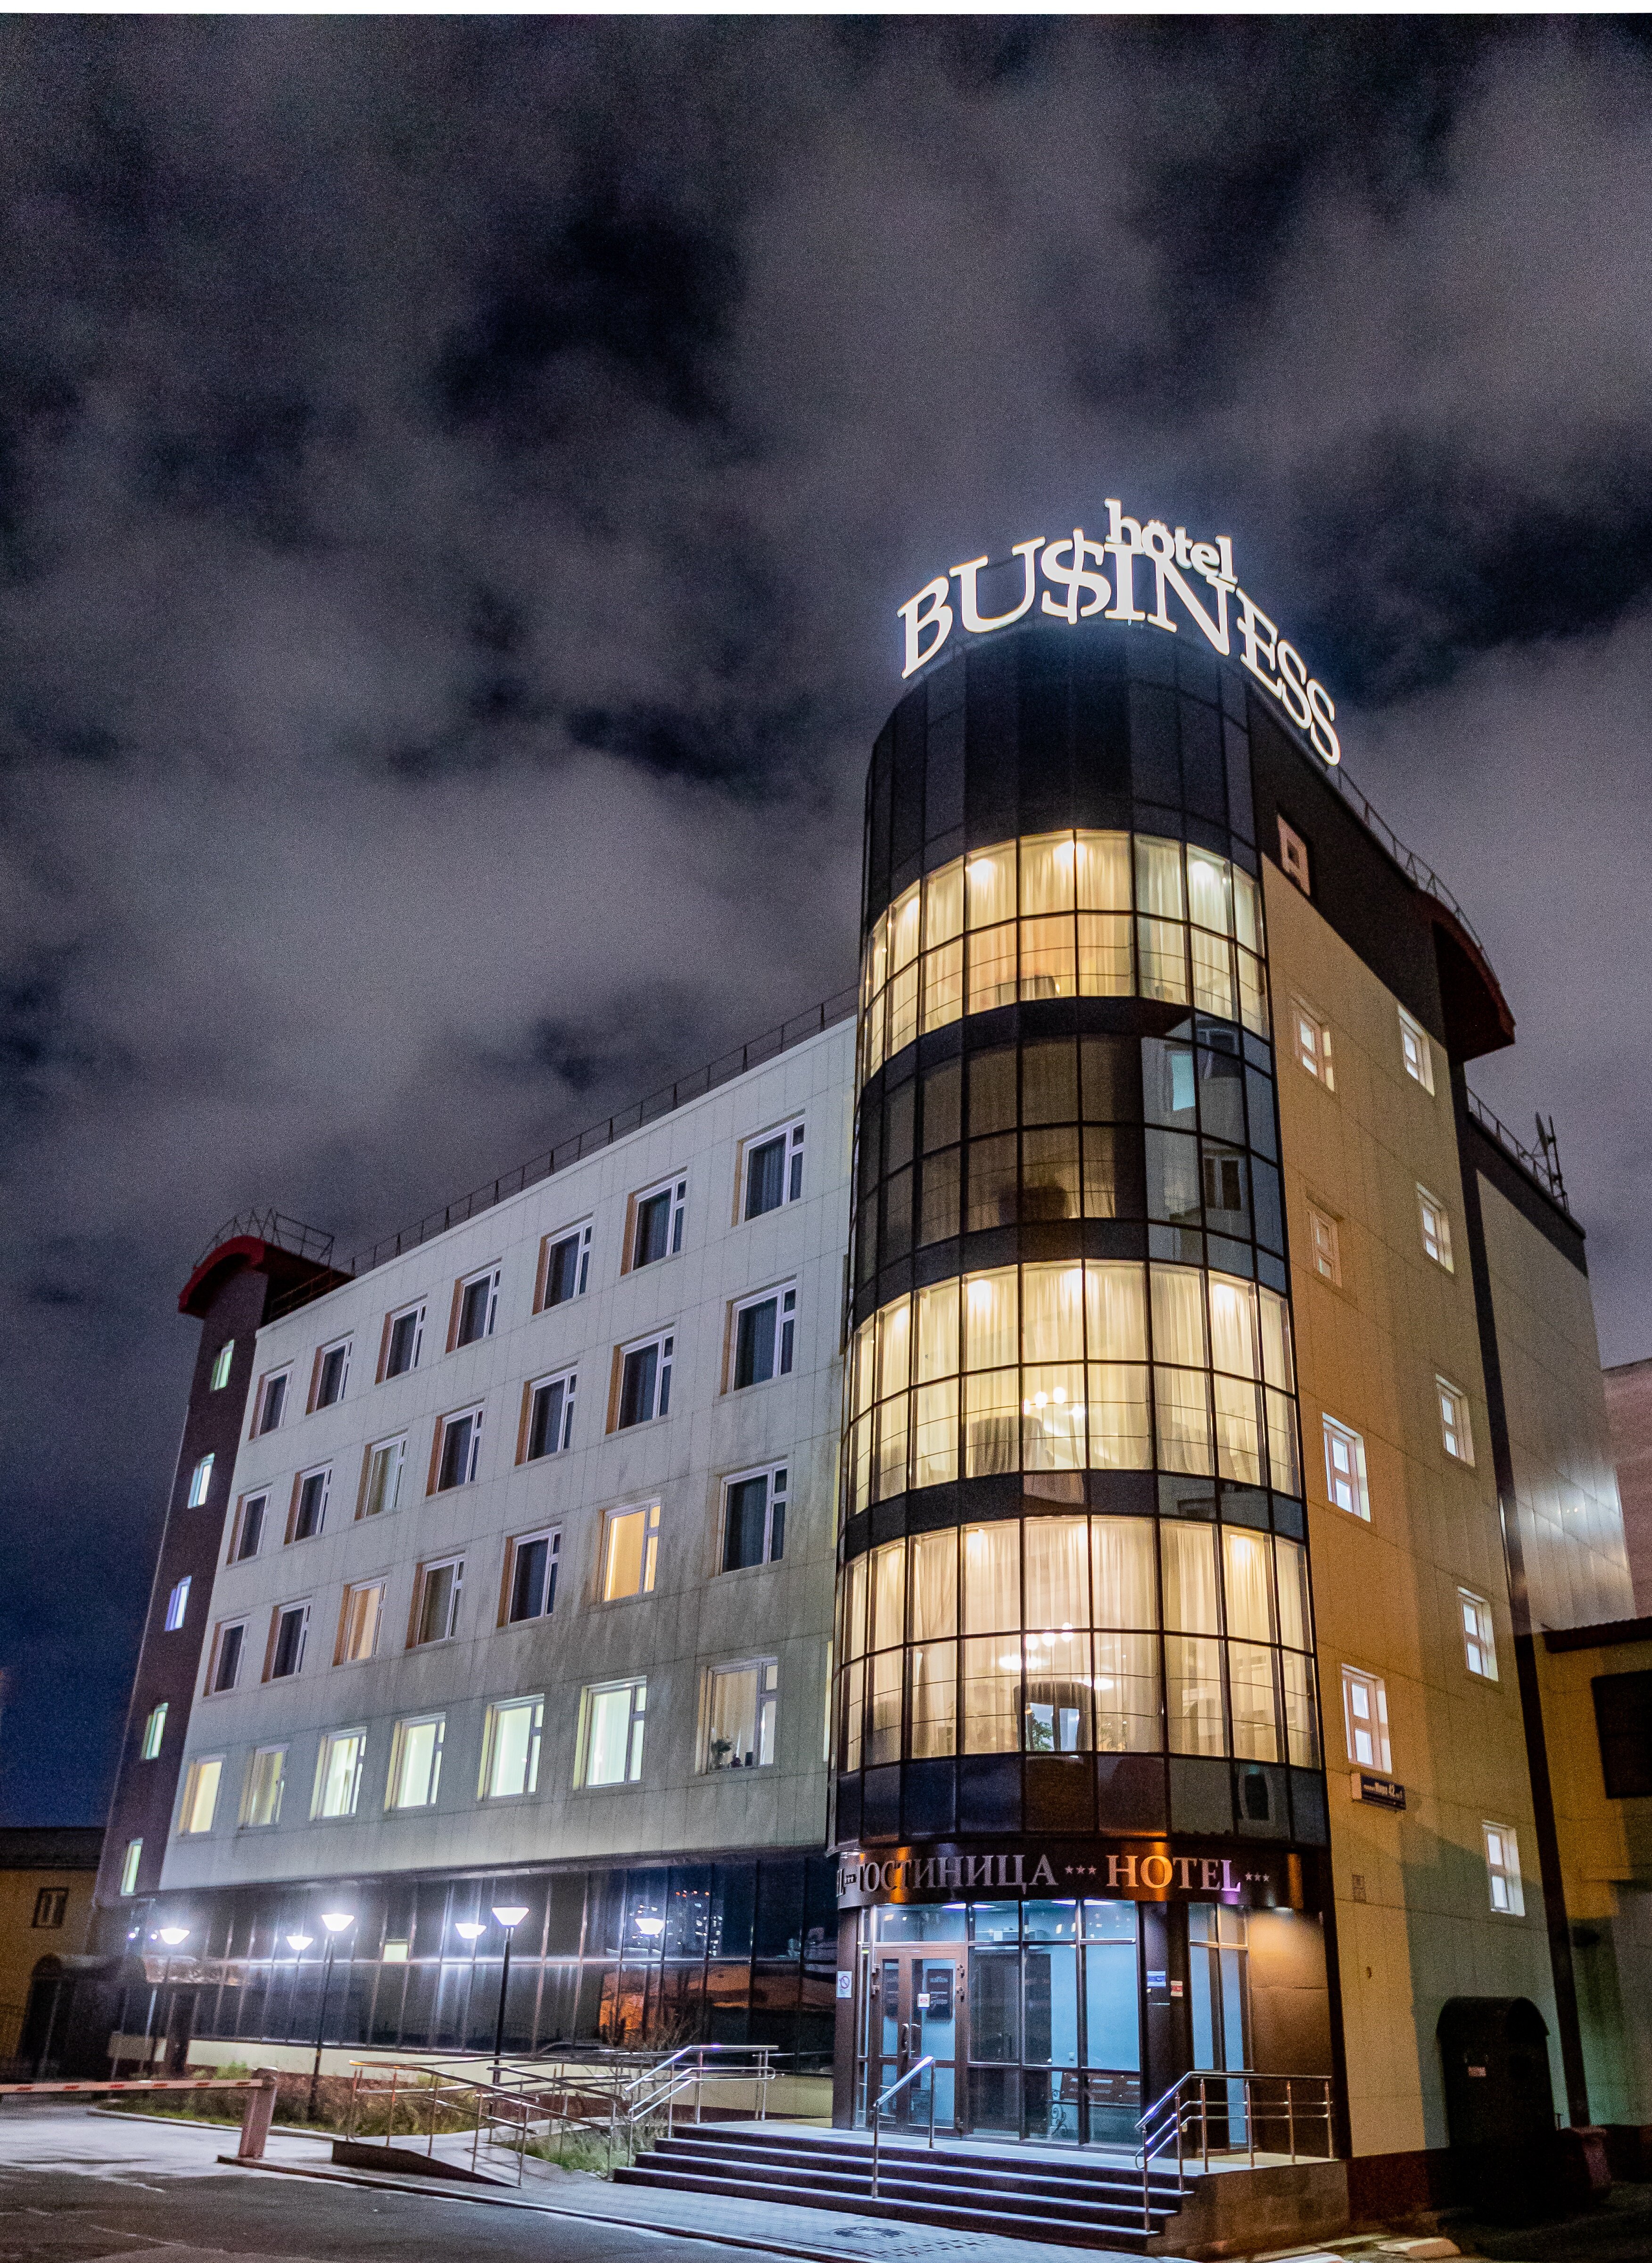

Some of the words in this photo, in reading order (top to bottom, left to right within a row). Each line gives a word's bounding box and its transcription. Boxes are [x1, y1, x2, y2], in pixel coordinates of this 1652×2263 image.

[1104, 498, 1238, 585] hotel
[859, 1854, 1058, 1895] ГОСТИНИЦА
[1106, 1855, 1241, 1892] HOTEL
